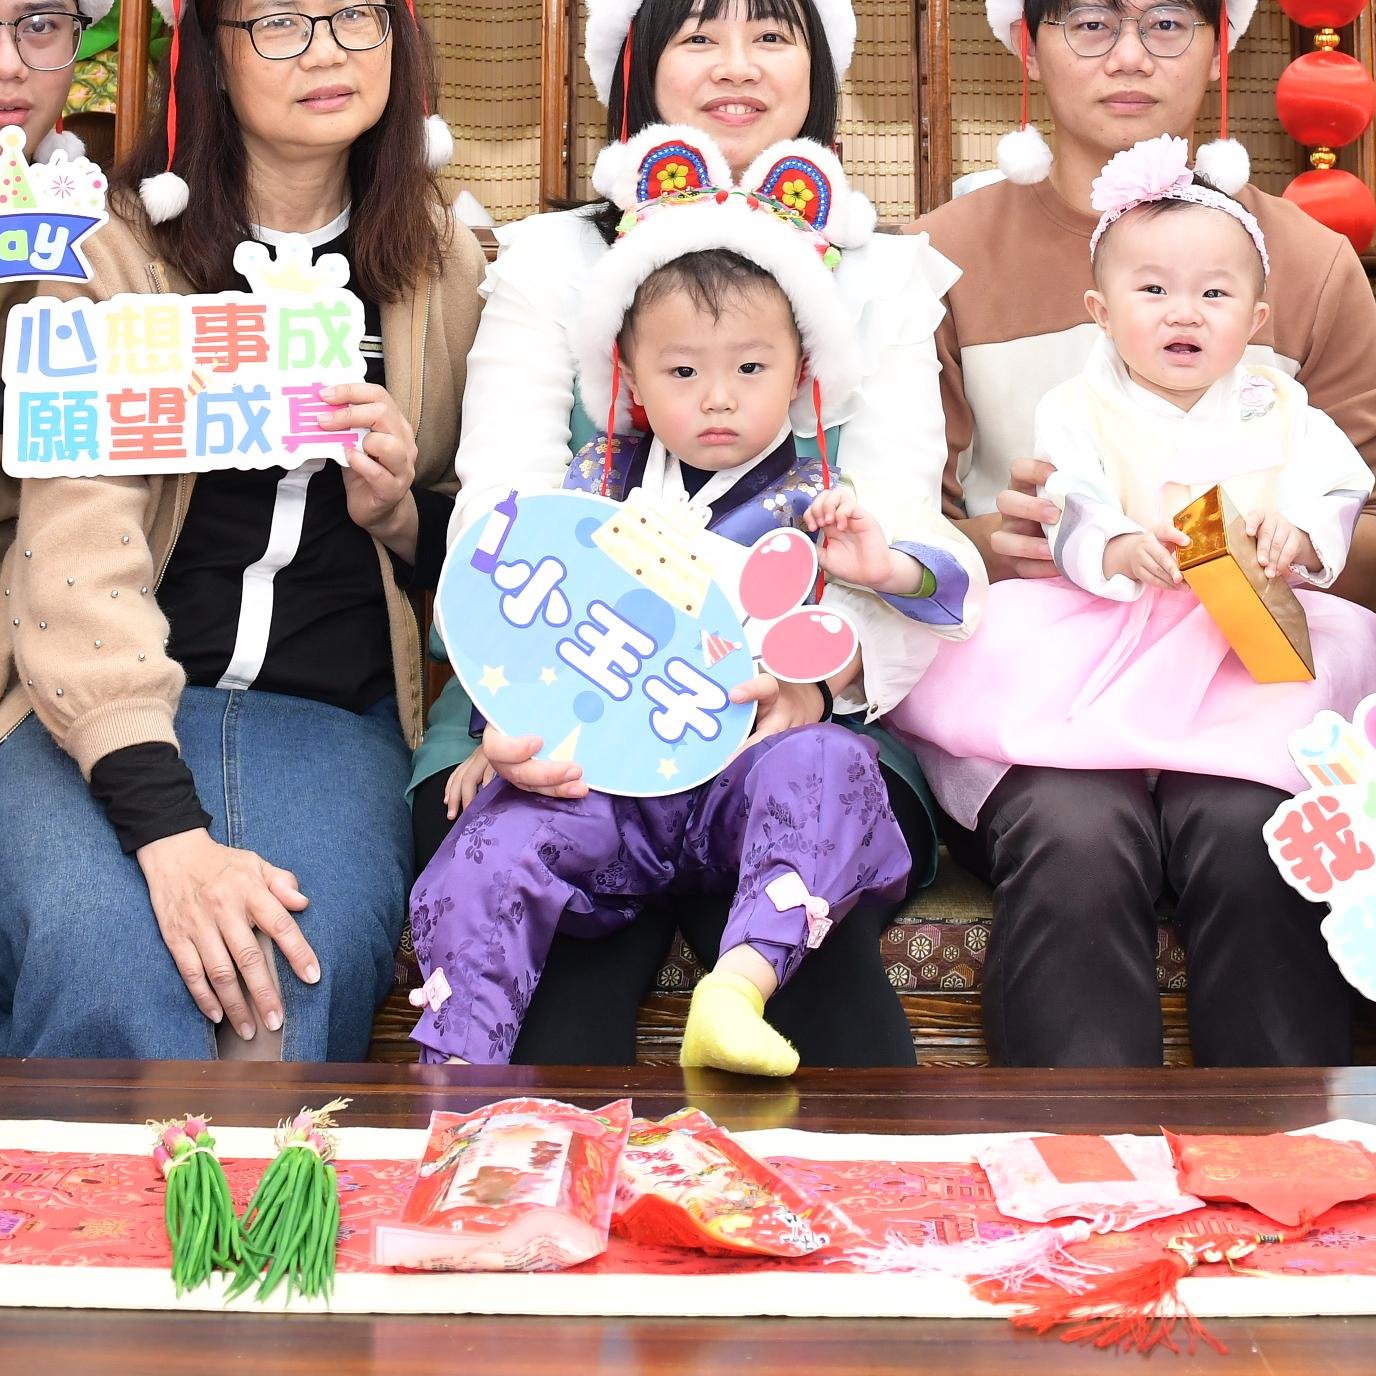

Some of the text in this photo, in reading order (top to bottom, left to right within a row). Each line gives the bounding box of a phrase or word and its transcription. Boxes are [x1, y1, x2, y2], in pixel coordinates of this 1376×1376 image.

[18, 302, 352, 377] 心想事成
[18, 384, 359, 463] 願望成真
[491, 556, 730, 743] 小王子
